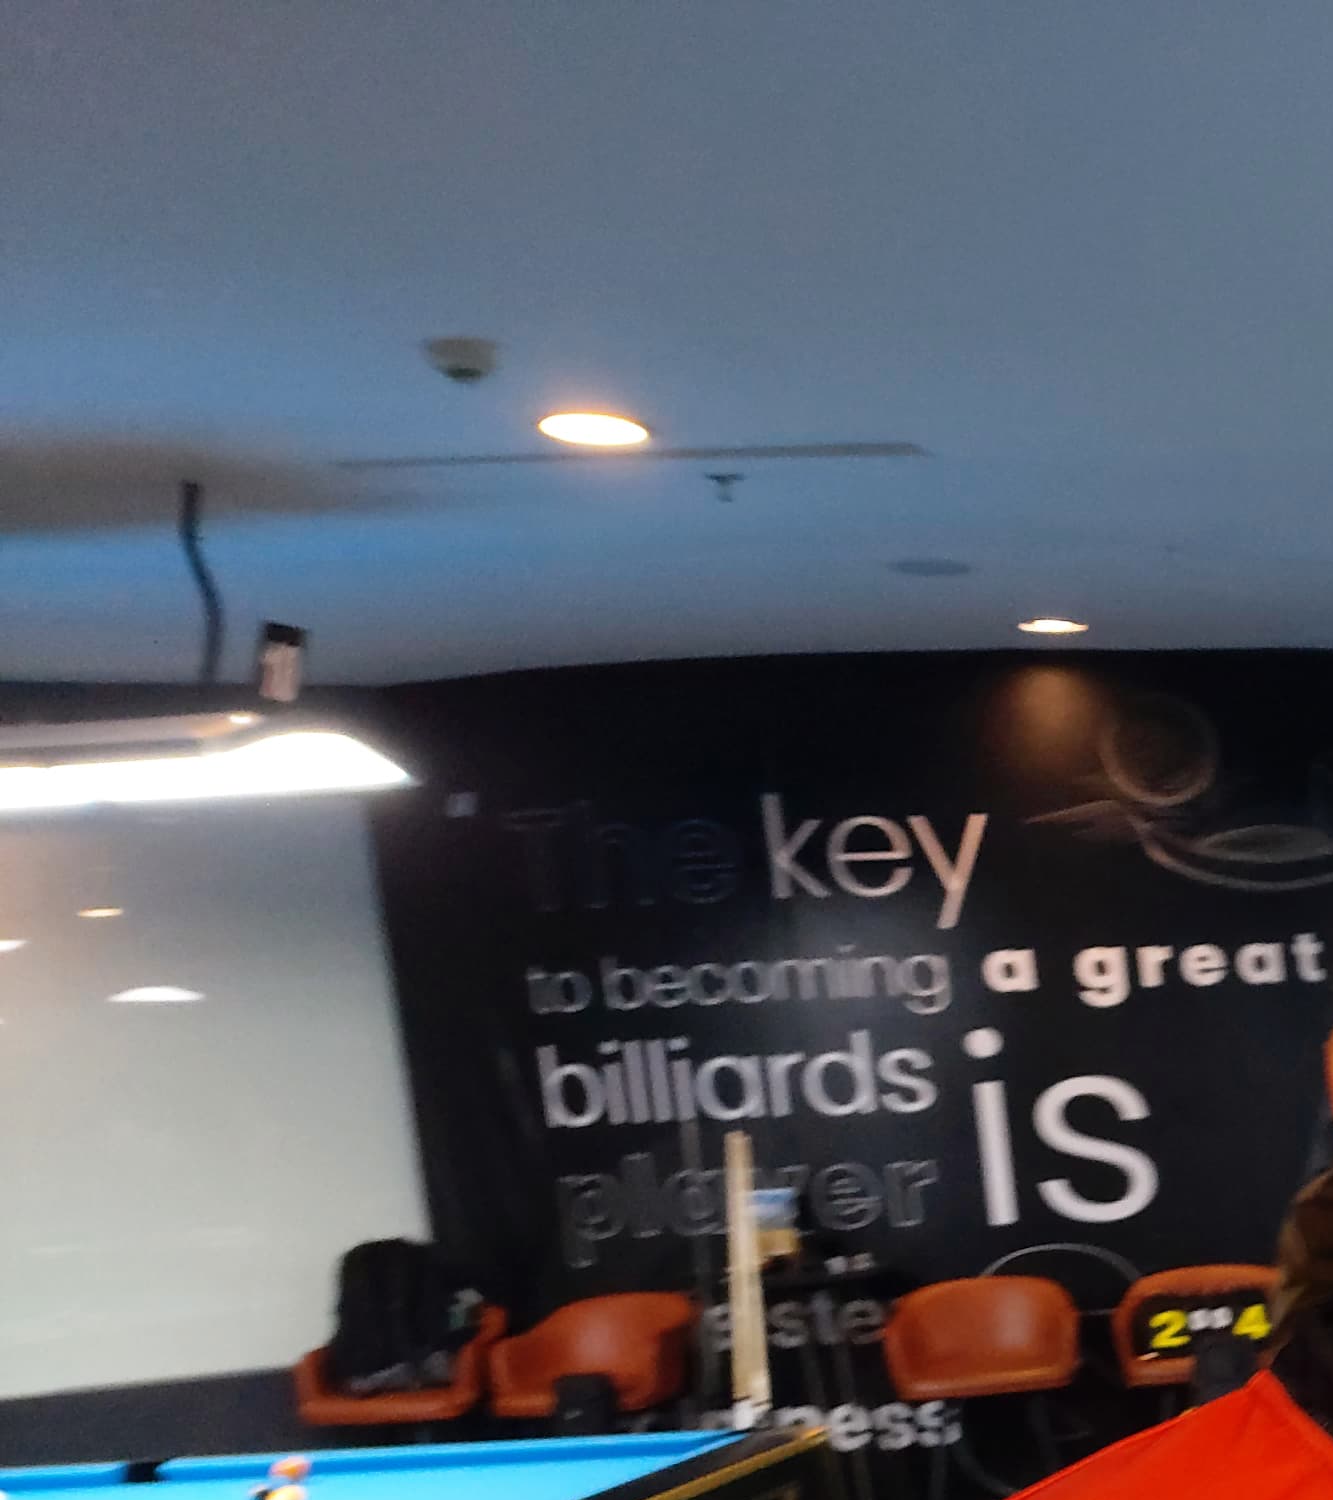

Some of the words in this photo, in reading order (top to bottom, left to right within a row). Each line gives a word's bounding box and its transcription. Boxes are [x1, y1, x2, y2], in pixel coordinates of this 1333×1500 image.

[762, 792, 989, 931] key
[524, 965, 593, 1014] to
[599, 943, 953, 1015] becoming
[982, 943, 1040, 995] a
[1073, 931, 1329, 1008] great
[535, 1029, 938, 1130] billiards
[961, 1026, 1162, 1229] is
[1148, 1309, 1192, 1349] 2
